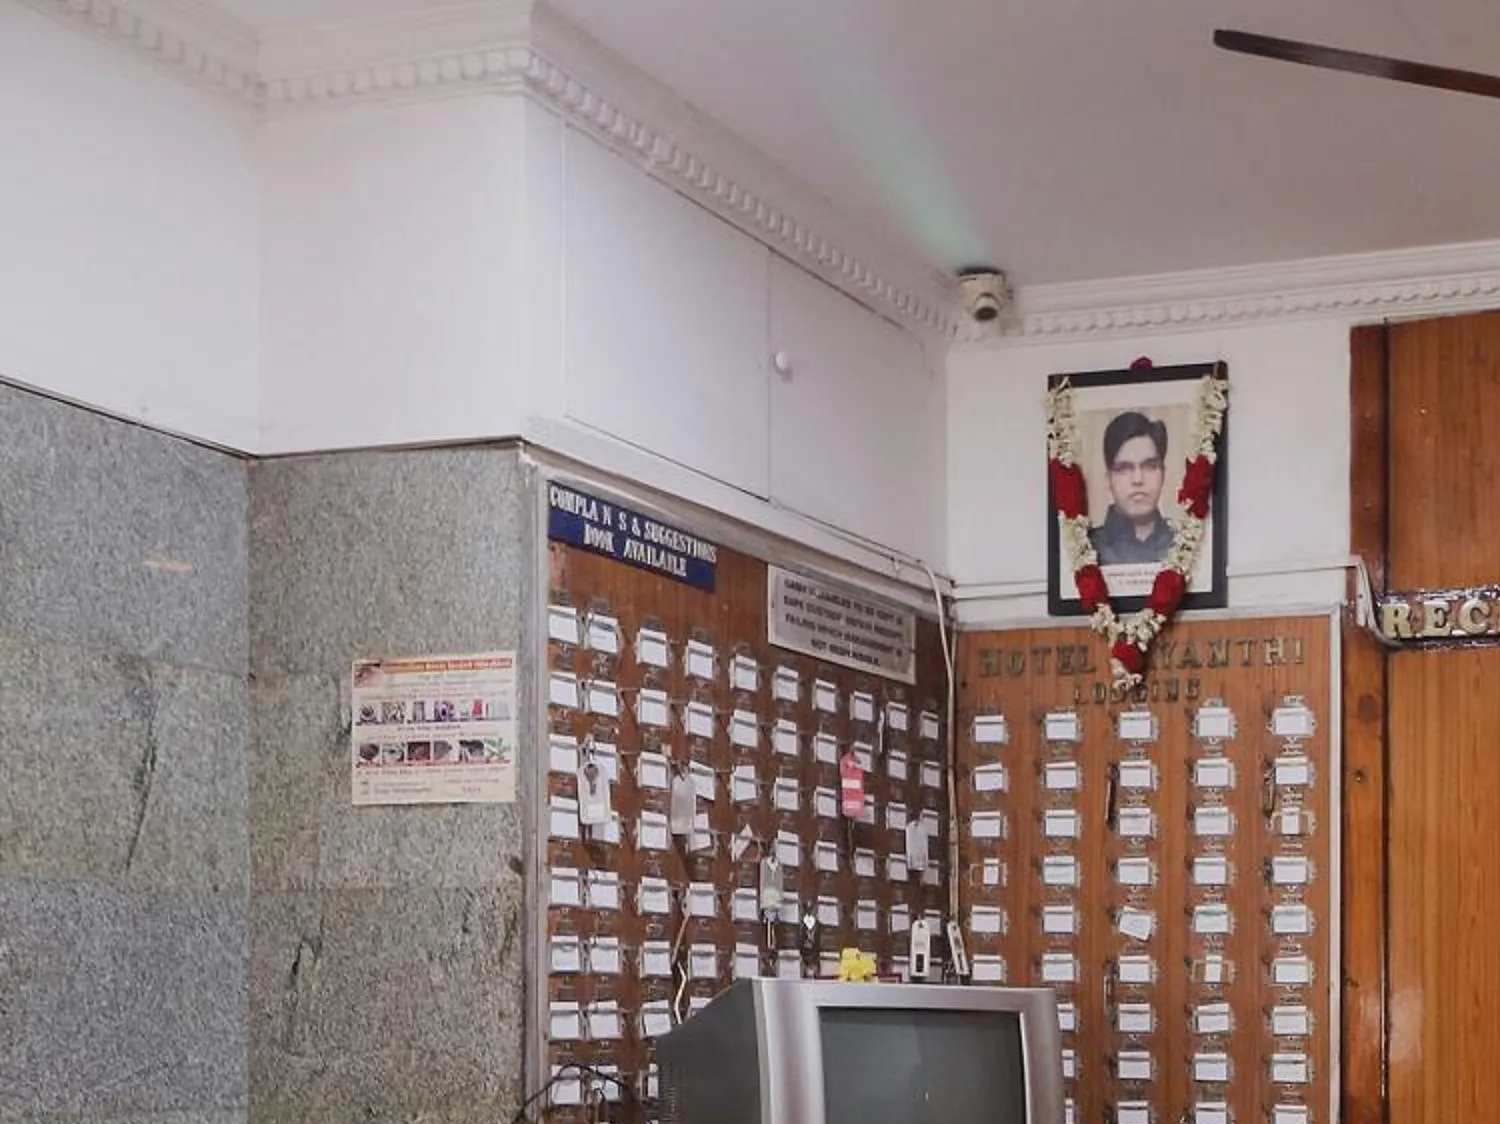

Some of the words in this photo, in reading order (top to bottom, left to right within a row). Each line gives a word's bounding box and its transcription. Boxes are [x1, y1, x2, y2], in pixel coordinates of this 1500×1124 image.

[631, 517, 641, 537] &
[644, 521, 717, 563] SUGGESTIONS
[978, 645, 1097, 678] HOTEL
